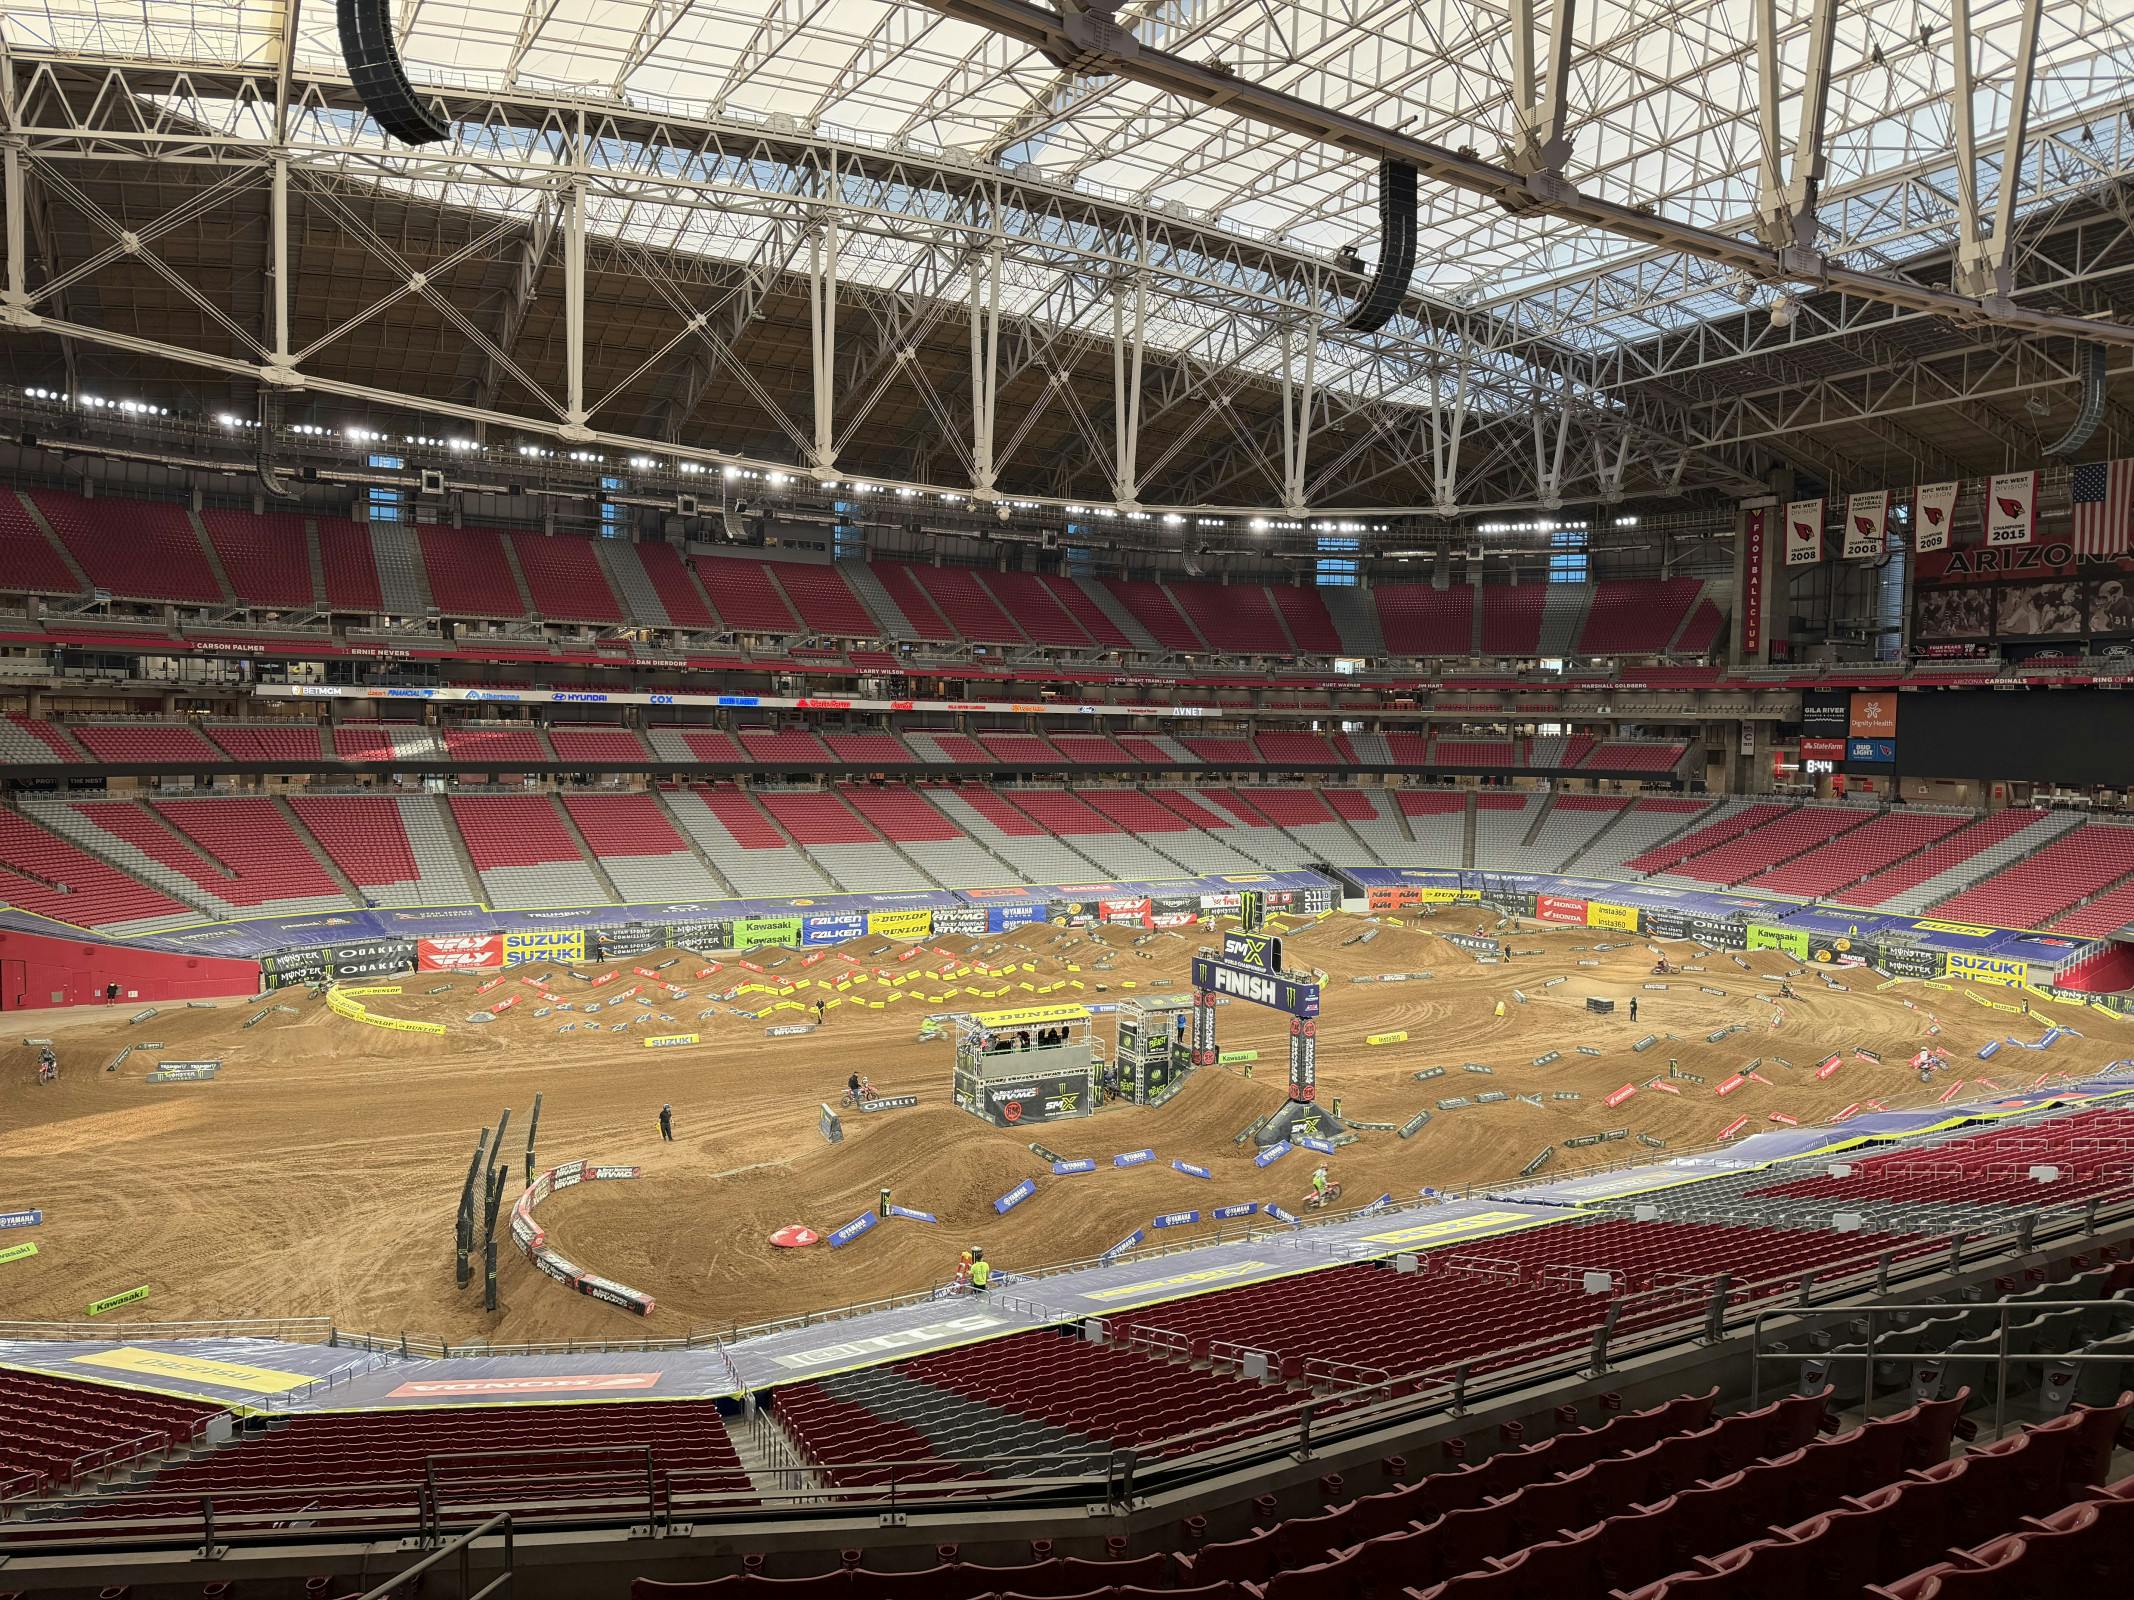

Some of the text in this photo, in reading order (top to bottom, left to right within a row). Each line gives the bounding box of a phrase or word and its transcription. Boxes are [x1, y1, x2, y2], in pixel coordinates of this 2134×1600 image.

[1993, 530, 2025, 540] 2015
[1920, 537, 1942, 548] 2009
[1848, 545, 1877, 554] 2008
[1791, 552, 1816, 561] 2008
[1173, 708, 1202, 716] AVNET
[1806, 760, 1832, 772] 8:44
[1305, 891, 1322, 902] 5.11
[1305, 903, 1322, 913] 5.11
[1553, 901, 1583, 910] HONDA
[1599, 905, 1626, 917] Insta360
[811, 915, 861, 926] FALKEN
[880, 913, 926, 923] DUNLOP
[1552, 912, 1582, 922] HONDA
[1599, 917, 1626, 928] Insta360
[678, 923, 720, 932] MONSTER
[746, 922, 791, 932] Kawasaki
[882, 926, 926, 936] DUNLOP
[1705, 921, 1744, 933] OAKLEY
[811, 929, 861, 939] FALKEN
[1705, 934, 1744, 945] OAKLEY
[1758, 929, 1797, 941] Kawasaki
[507, 933, 581, 947] SUZUKI
[678, 937, 720, 946] MONSTER
[746, 935, 791, 945] Kawasaki
[1453, 938, 1494, 950] OAKLEY
[359, 944, 413, 955] OAKLEY
[507, 948, 581, 961] SUZUKI
[1225, 939, 1266, 966] SMX
[1889, 946, 1932, 959] MONSTER
[277, 951, 319, 965] MONSTER
[1238, 962, 1266, 973] CHAMPIONSHIP
[1889, 961, 1931, 973] MONSTER
[1951, 955, 2023, 975] SUZUKI
[281, 966, 321, 981] MONSTER
[599, 974, 612, 982] FLY
[1215, 967, 1276, 1004] FINISH
[499, 999, 513, 1008] FLY
[1966, 991, 1988, 1005] SUZUKI
[999, 1007, 1081, 1020] DUNLOP
[2031, 1011, 2053, 1024] SUZUKI
[365, 1016, 394, 1027] DUNLOP
[652, 1037, 693, 1046] SUZUKI
[1149, 1036, 1167, 1049] BEAST
[1120, 1081, 1134, 1092] BEAST
[1725, 1078, 1741, 1090] HONDA
[1615, 1088, 1634, 1102] HONDA
[878, 1097, 916, 1107] OAKLEY
[1045, 1096, 1076, 1111] SMX
[1291, 1119, 1318, 1133] SMX
[1128, 1151, 1146, 1161] YAMAHA
[1270, 1145, 1284, 1158] YAMAHA
[1069, 1162, 1086, 1170] YAMAHA
[1009, 1187, 1027, 1203] YAMAHA
[1232, 1205, 1250, 1215] YAMAHA
[7, 1215, 34, 1224] YAMAHA
[1172, 1212, 1191, 1222] YAMAHA
[845, 1218, 866, 1236] YAMAHA
[1116, 1235, 1136, 1256] YAMAHA
[96, 1289, 143, 1312] Kawasaki
